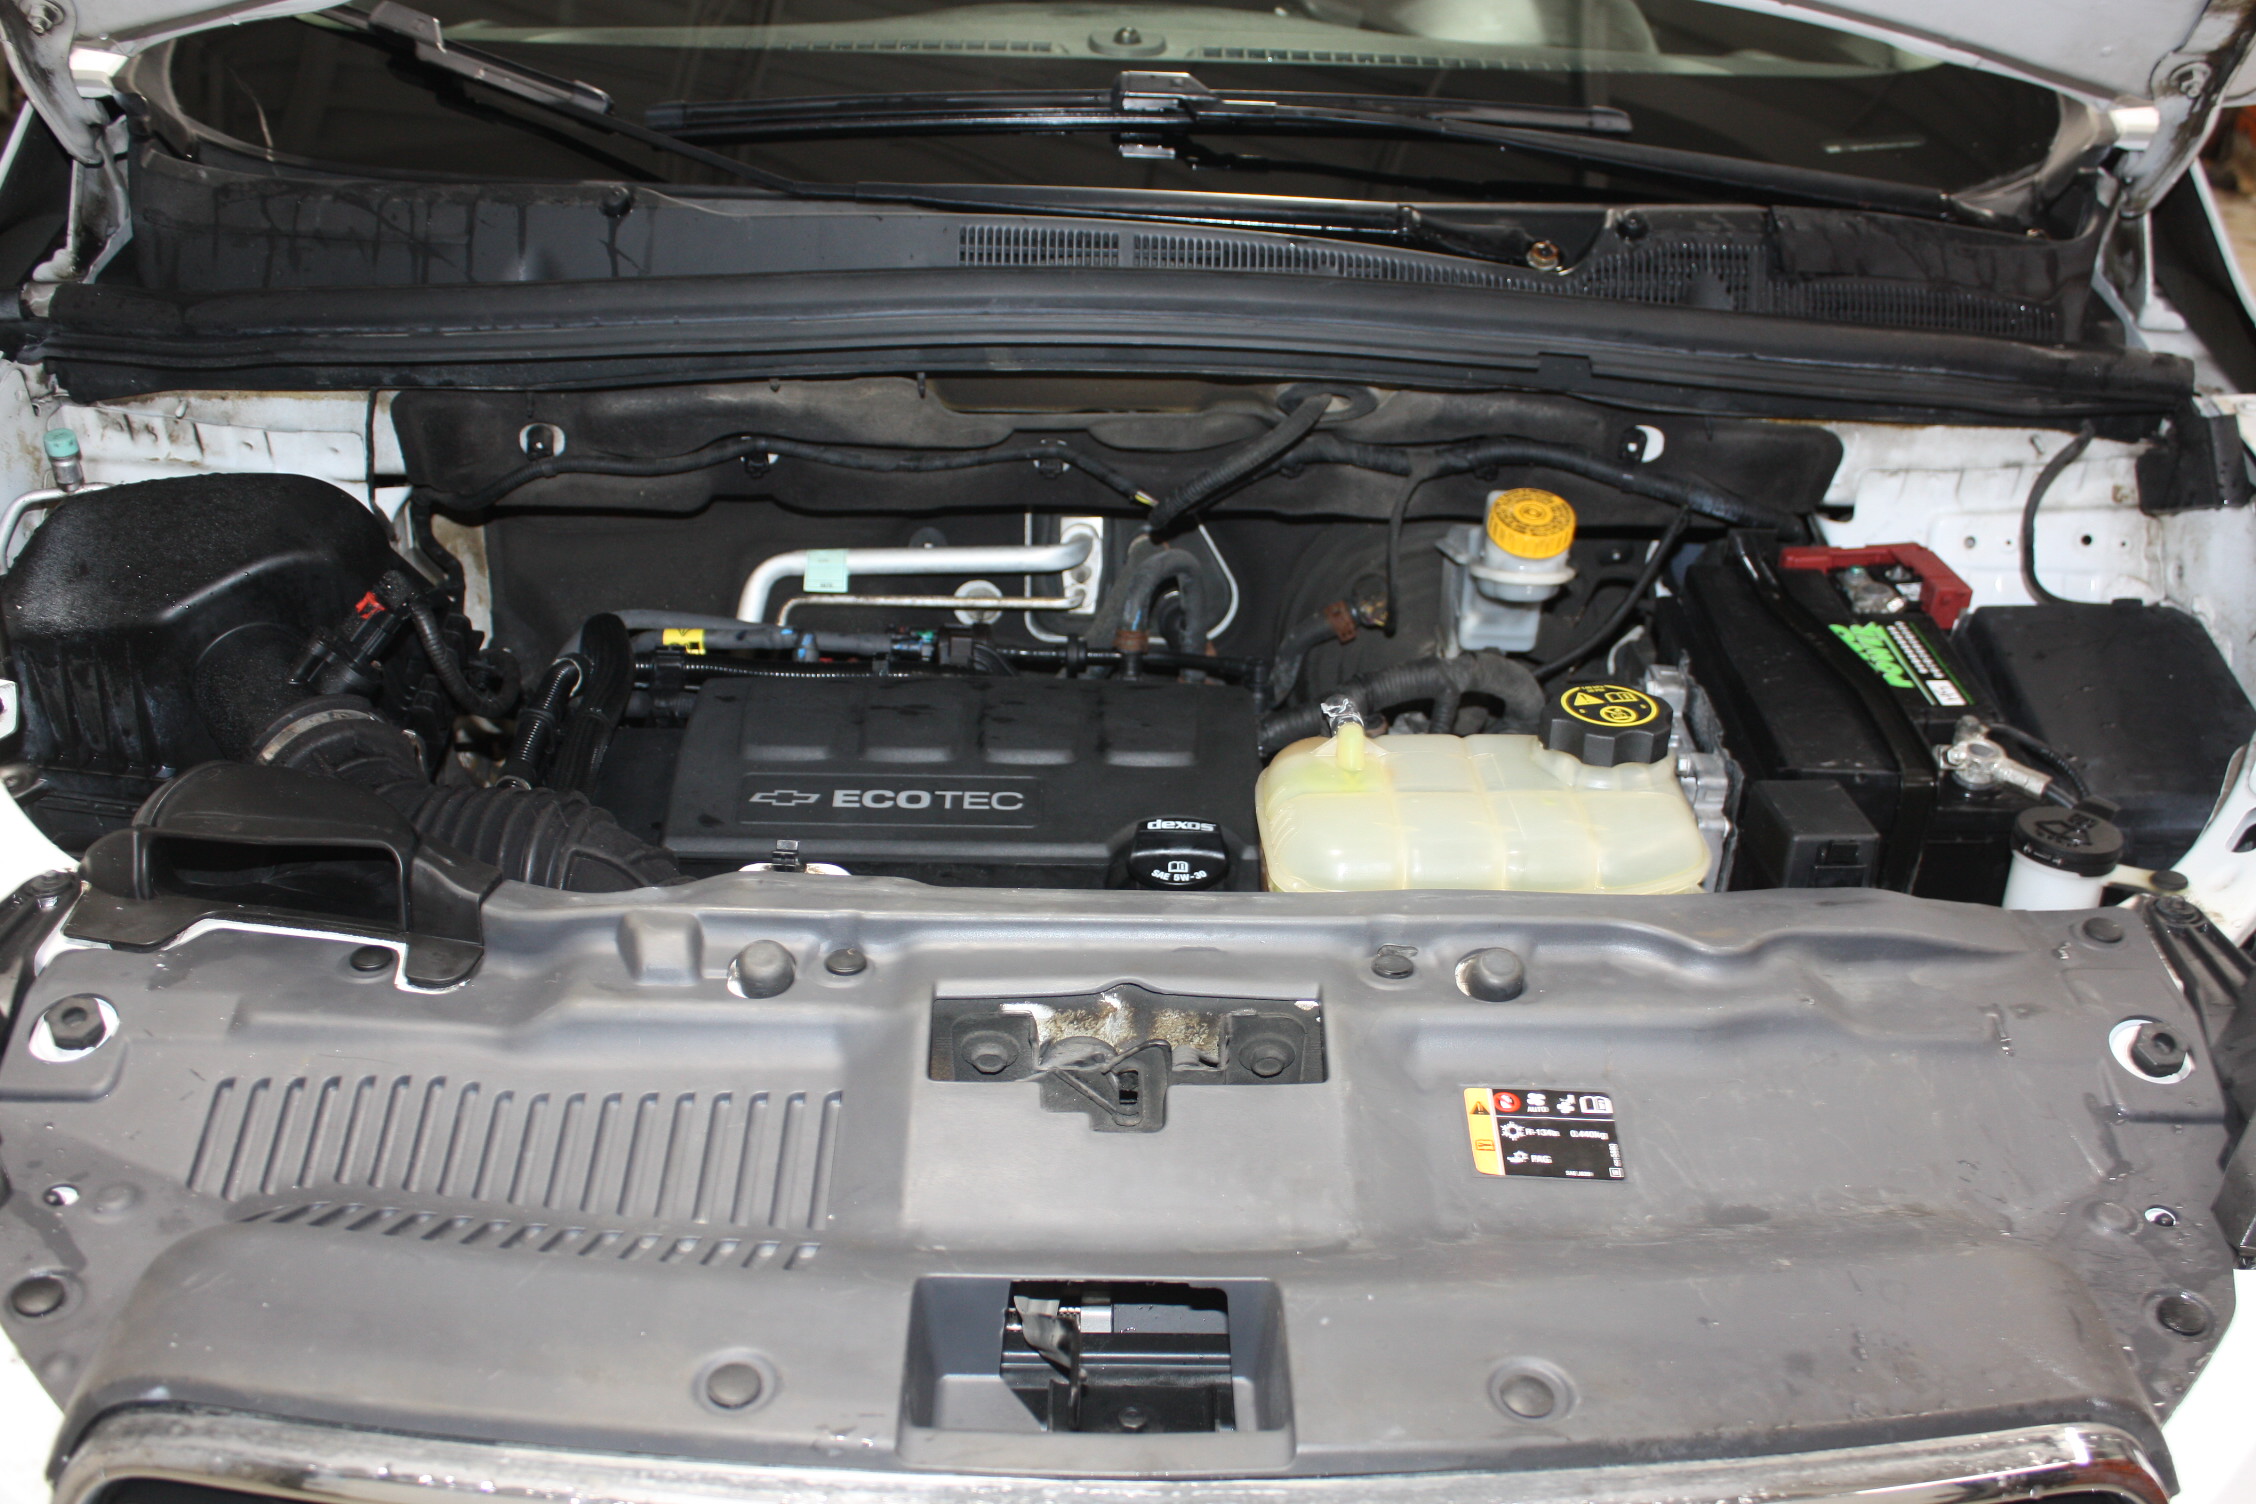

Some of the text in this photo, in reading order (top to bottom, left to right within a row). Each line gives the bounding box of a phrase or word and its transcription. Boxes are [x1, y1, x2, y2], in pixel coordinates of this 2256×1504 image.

[832, 789, 1024, 811] ECOTEC
[1147, 819, 1216, 832] dexos
[1151, 869, 1207, 882] SAE 5W-30
[1527, 1105, 1549, 1113] AUTO
[1530, 1154, 1553, 1164] PAG
